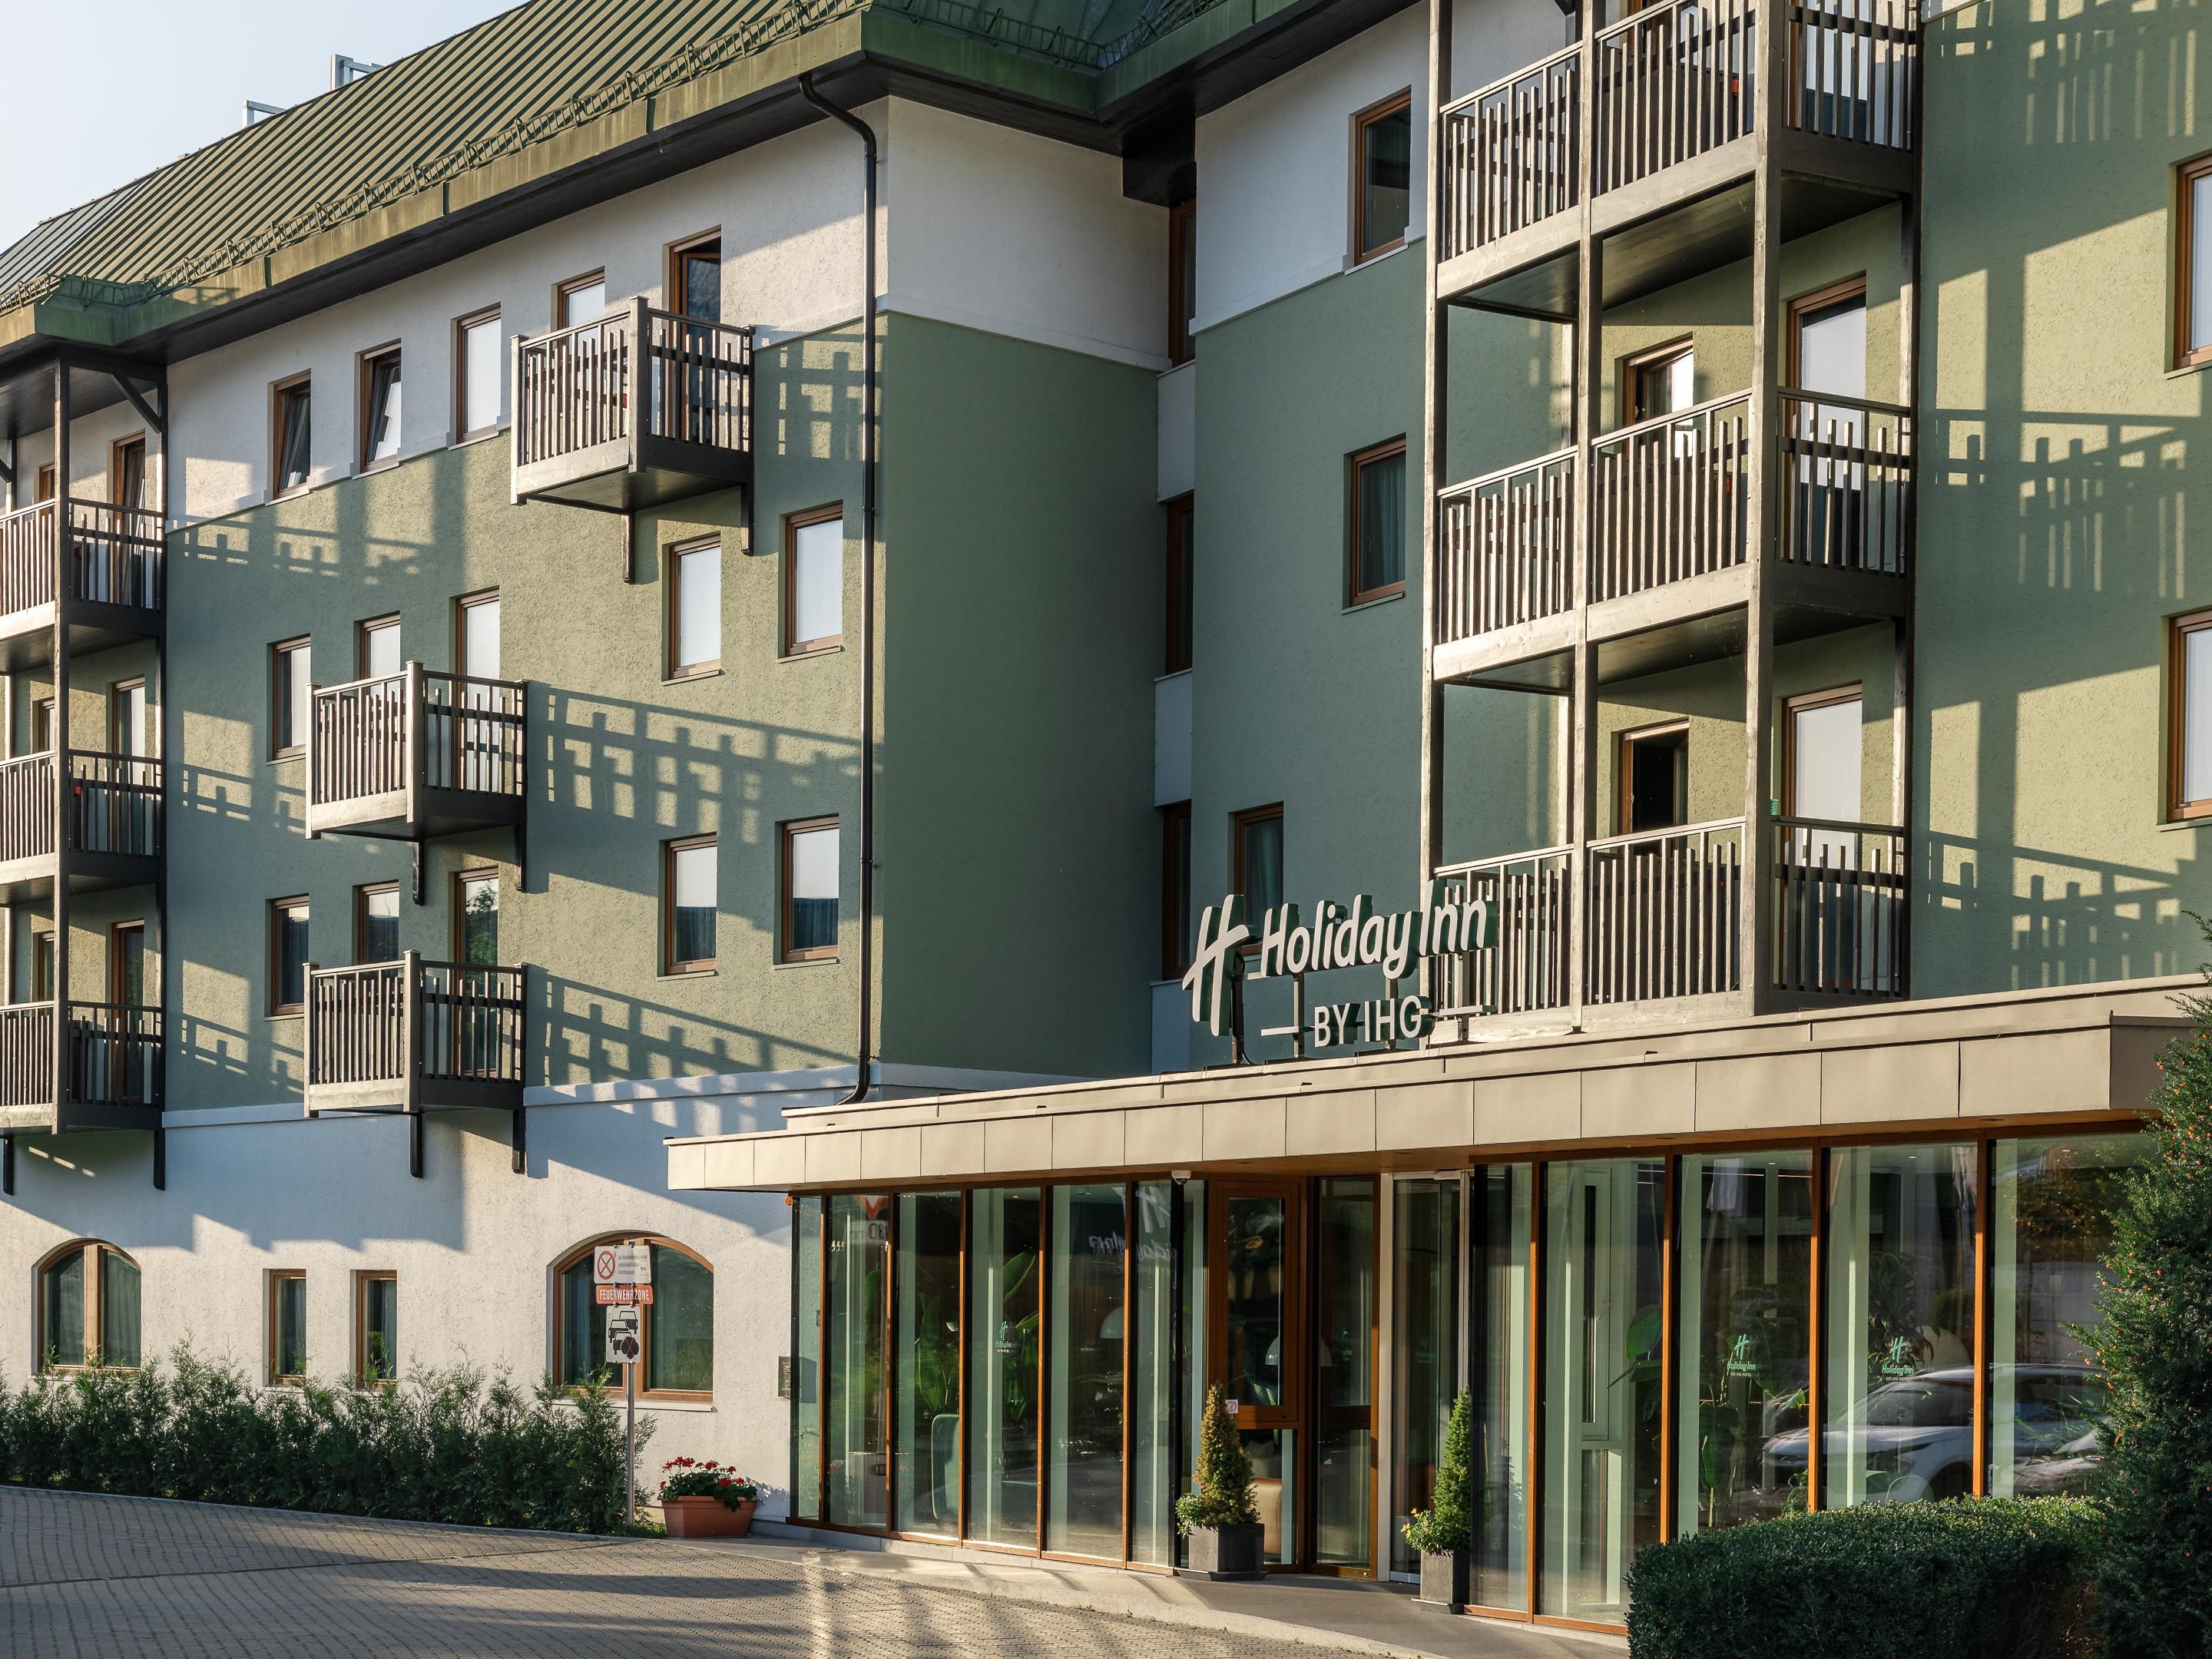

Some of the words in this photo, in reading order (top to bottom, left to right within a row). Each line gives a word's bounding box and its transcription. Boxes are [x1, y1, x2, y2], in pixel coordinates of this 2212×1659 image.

[1260, 893, 1414, 980] Holiday
[1419, 879, 1488, 957] Inn
[1314, 1002, 1352, 1048] BY
[1364, 994, 1426, 1043] IHG
[599, 1289, 650, 1301] FEUERWEHRZONE
[1727, 1360, 1747, 1372] Holiday
[1881, 1363, 1904, 1376] Holiday
